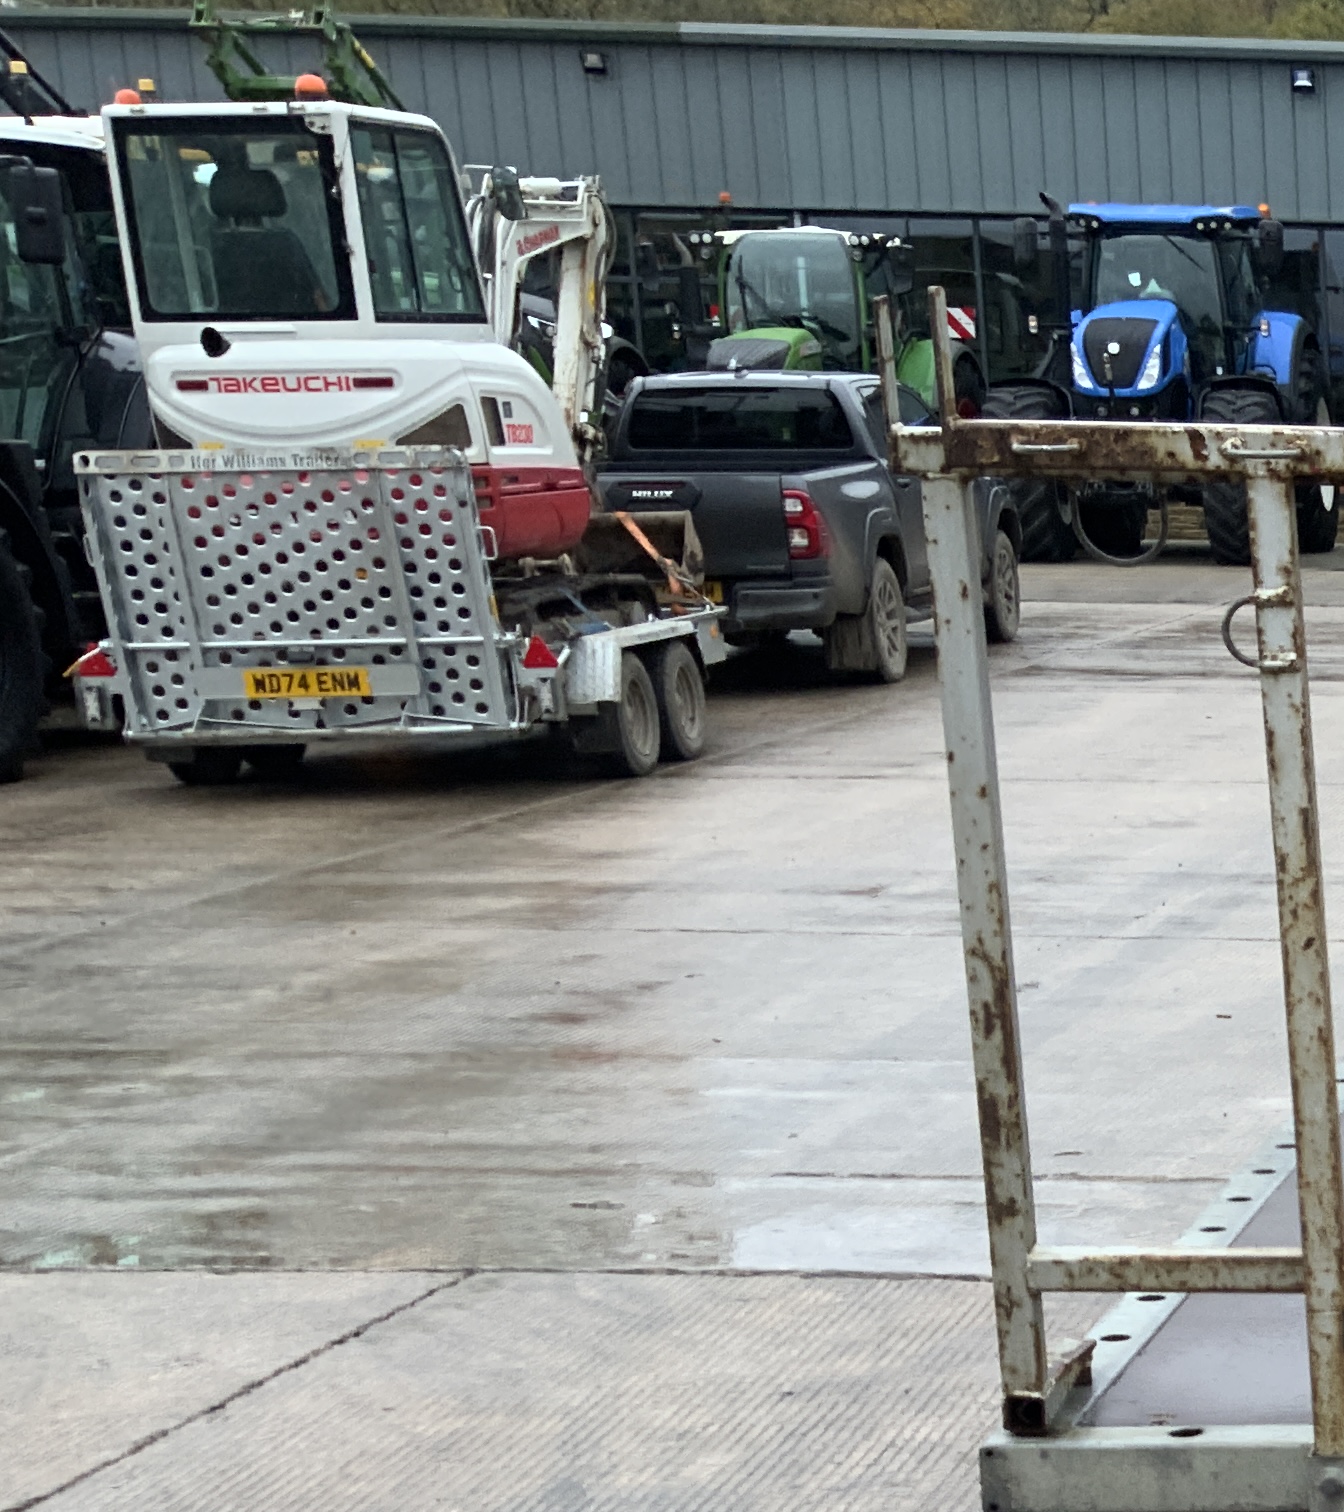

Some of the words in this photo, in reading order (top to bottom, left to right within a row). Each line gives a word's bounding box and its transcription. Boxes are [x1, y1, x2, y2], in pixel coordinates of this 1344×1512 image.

[208, 376, 351, 393] TAKEUCHI
[291, 453, 350, 468] Trailer
[252, 673, 310, 694] WD74
[316, 671, 361, 692] ENM
